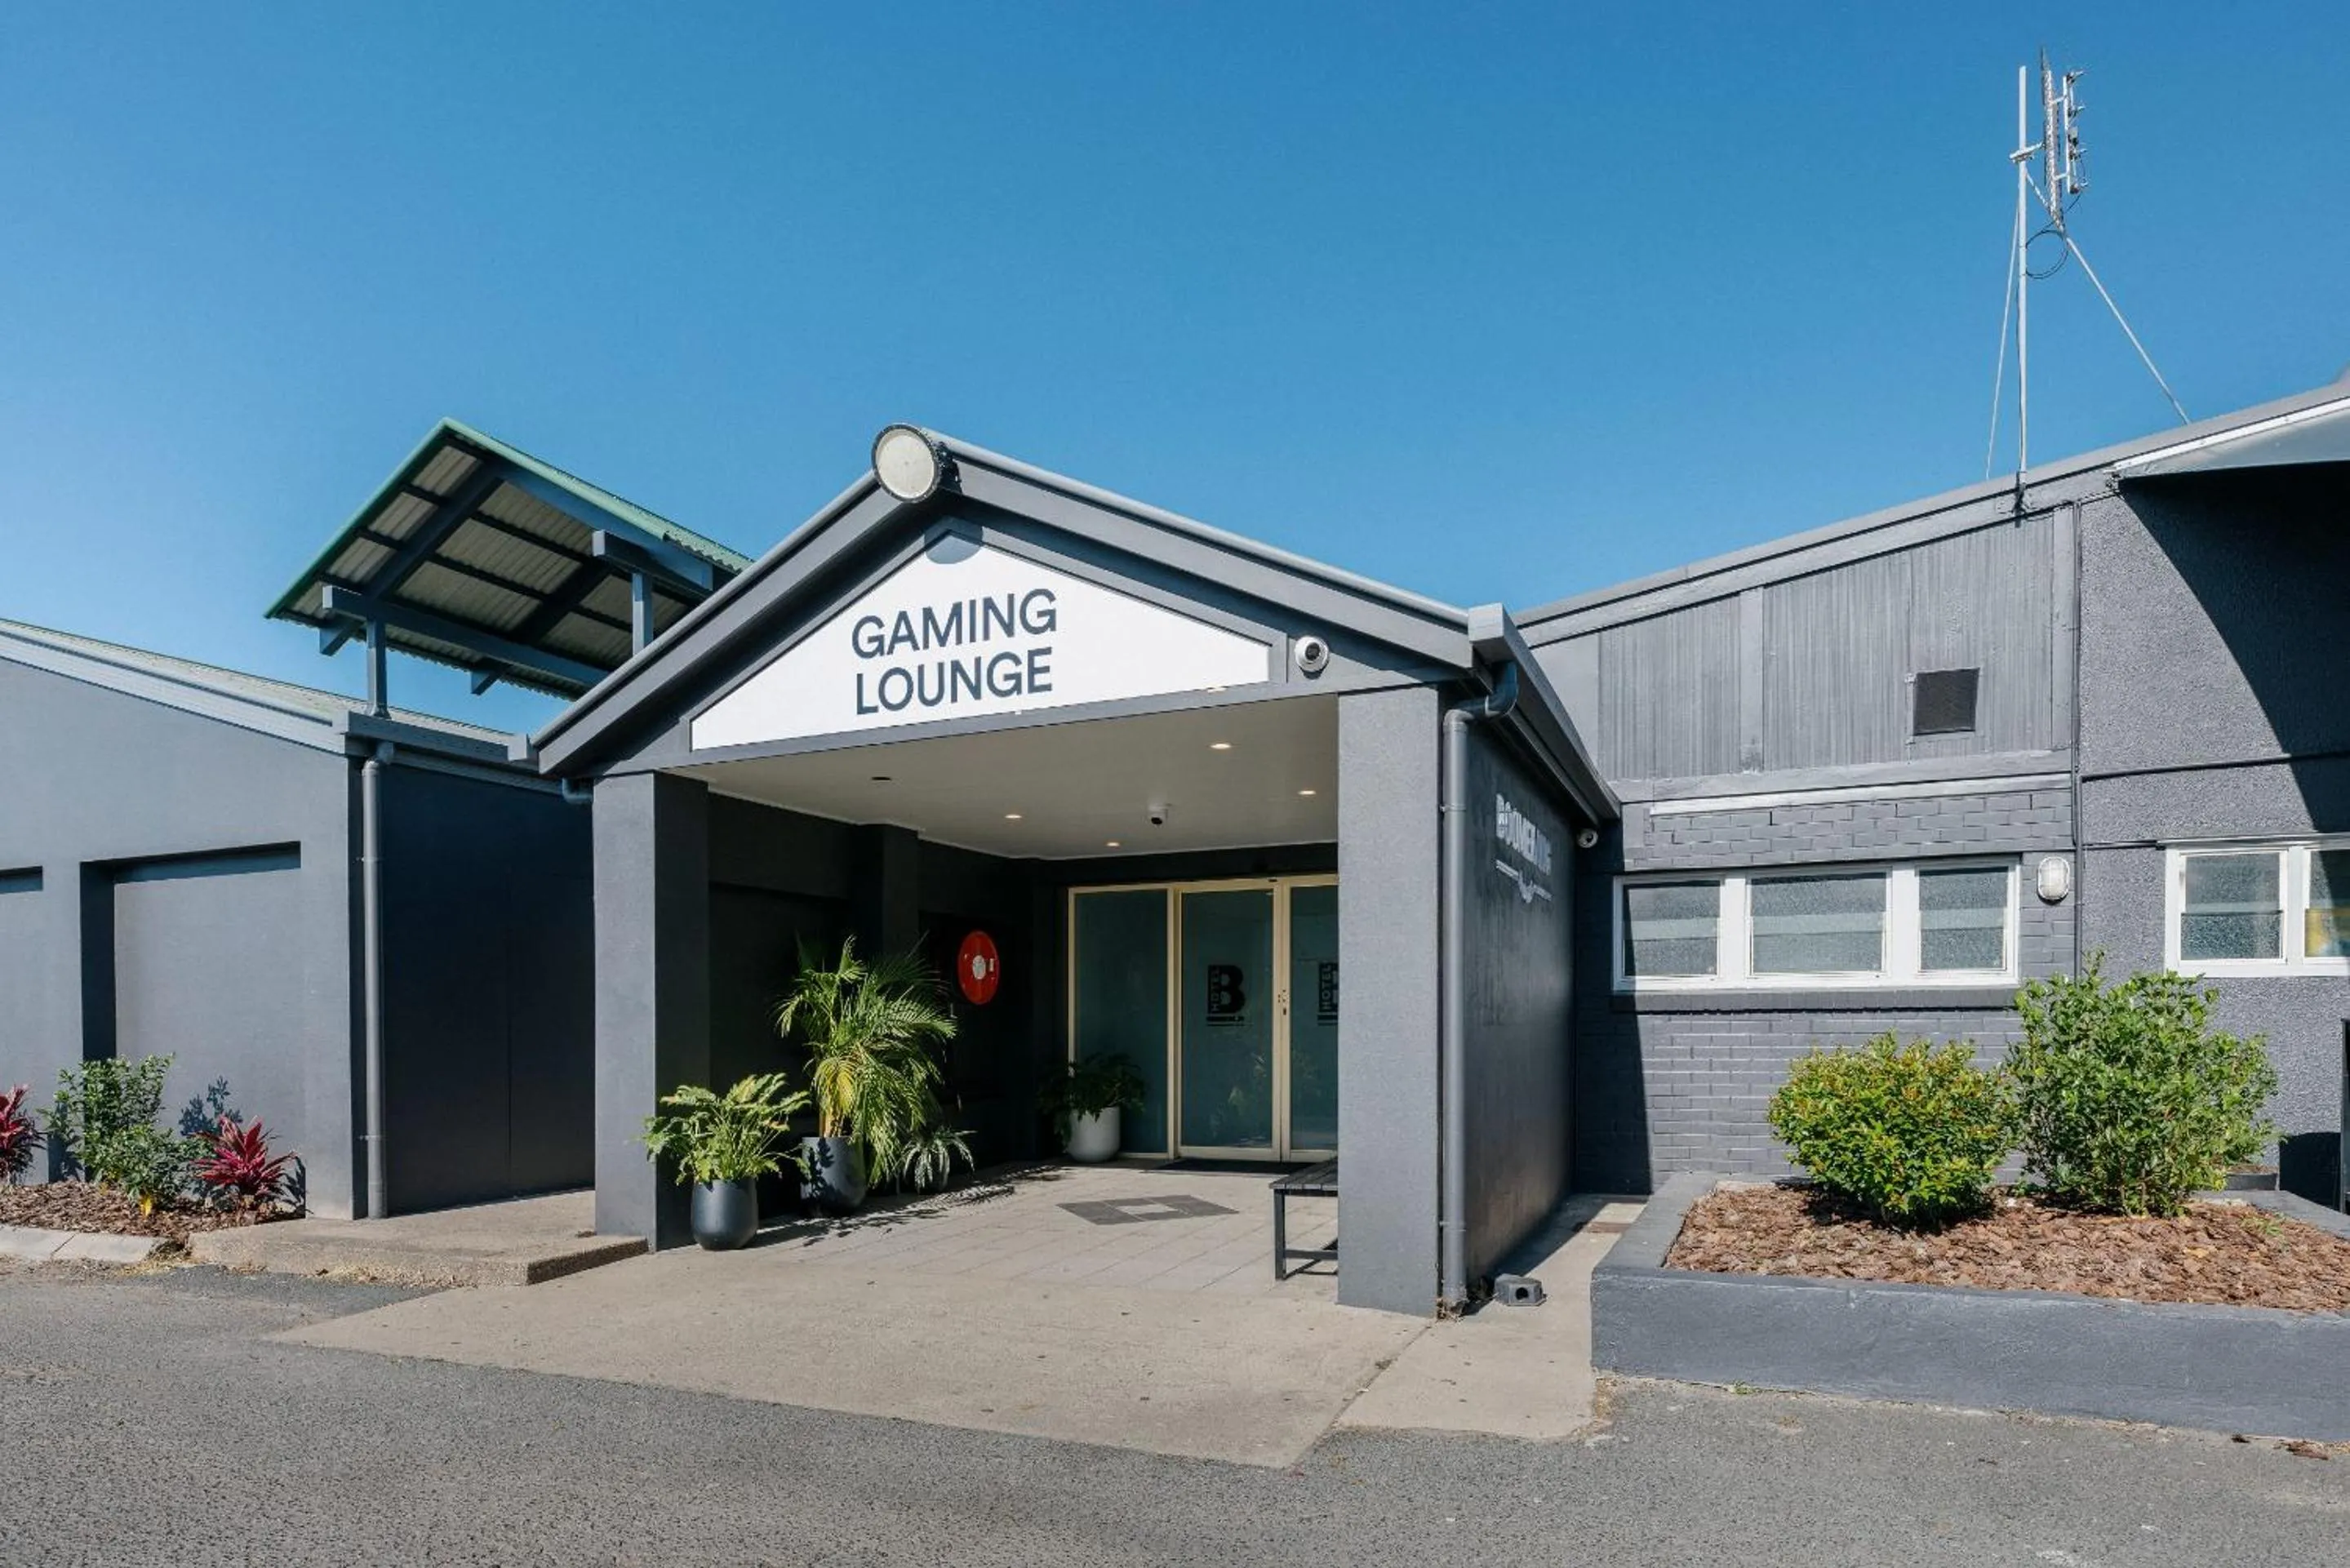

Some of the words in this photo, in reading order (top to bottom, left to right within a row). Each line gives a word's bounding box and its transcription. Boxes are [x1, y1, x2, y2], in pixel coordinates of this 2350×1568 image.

[851, 589, 1057, 659] GAMING
[856, 646, 1053, 715] LOUNGE
[1208, 965, 1246, 1014] B
[1322, 963, 1332, 1011] HOTEL
